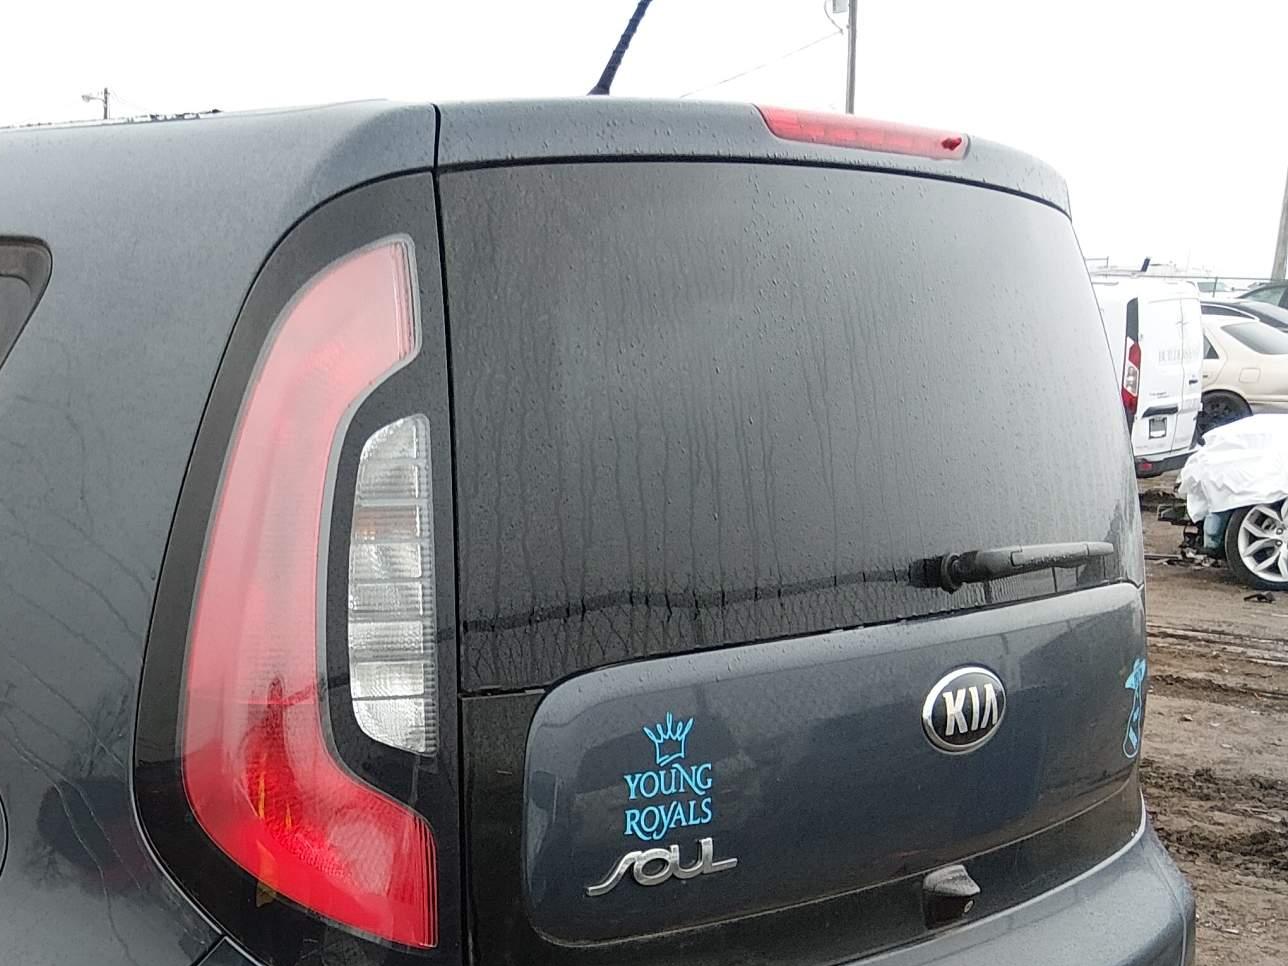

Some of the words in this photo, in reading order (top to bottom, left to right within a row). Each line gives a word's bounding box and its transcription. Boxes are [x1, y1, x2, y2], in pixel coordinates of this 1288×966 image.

[943, 683, 999, 736] KIA
[624, 763, 712, 800] YOUNG
[624, 797, 712, 841] ROYALS
[585, 837, 738, 896] SOUL
